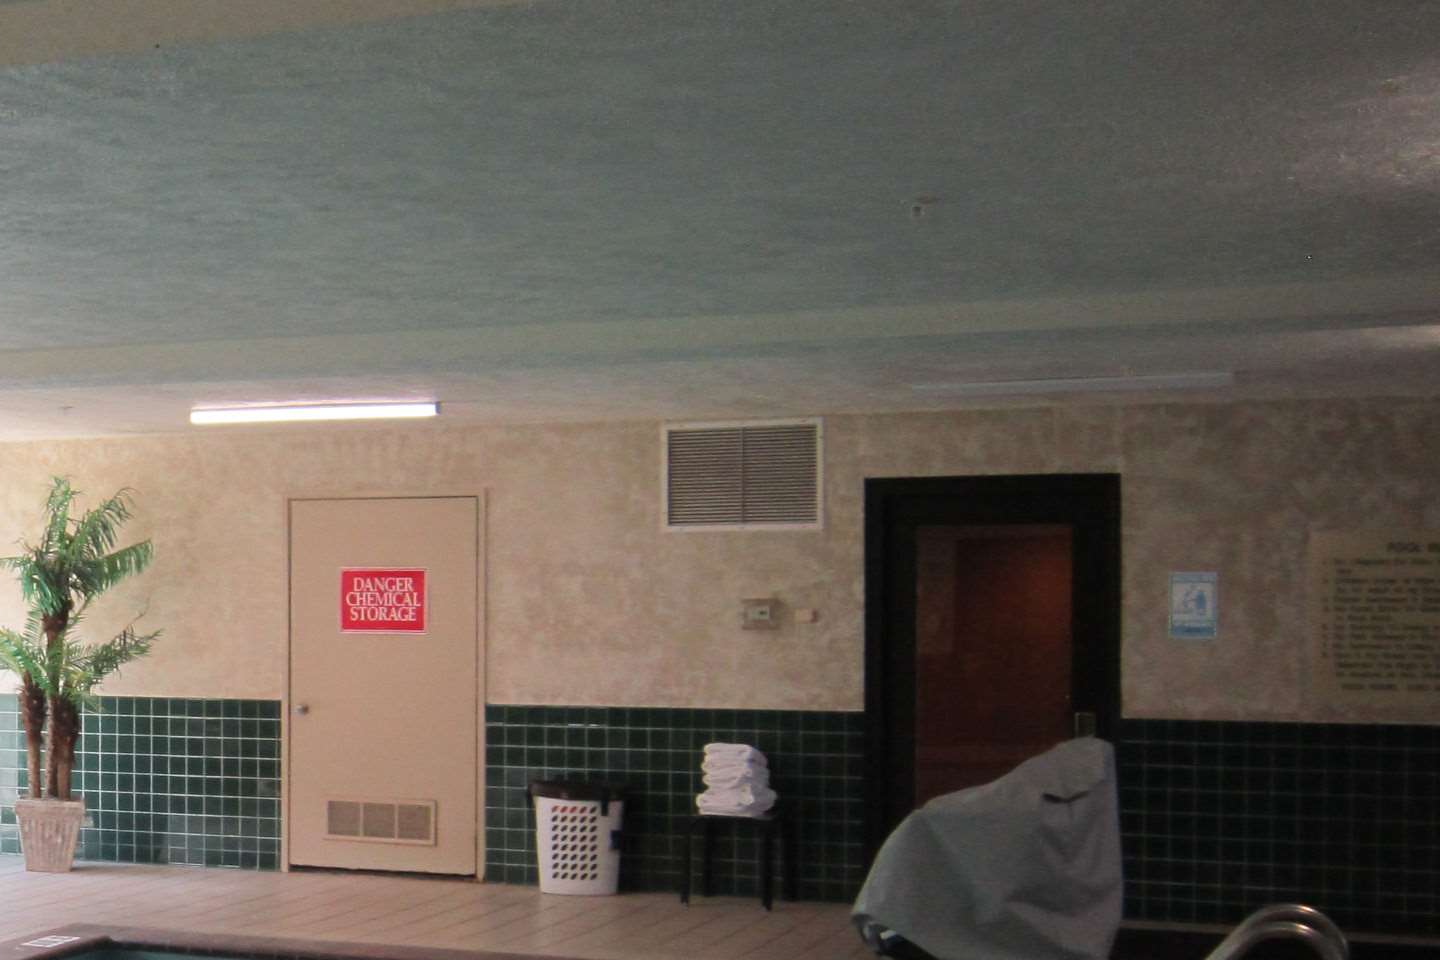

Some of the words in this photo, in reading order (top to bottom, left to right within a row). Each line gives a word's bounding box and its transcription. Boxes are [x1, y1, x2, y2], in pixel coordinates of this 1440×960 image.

[353, 577, 413, 592] DANGER
[346, 592, 421, 607] CHEMICAL
[350, 606, 417, 621] STORAGE
